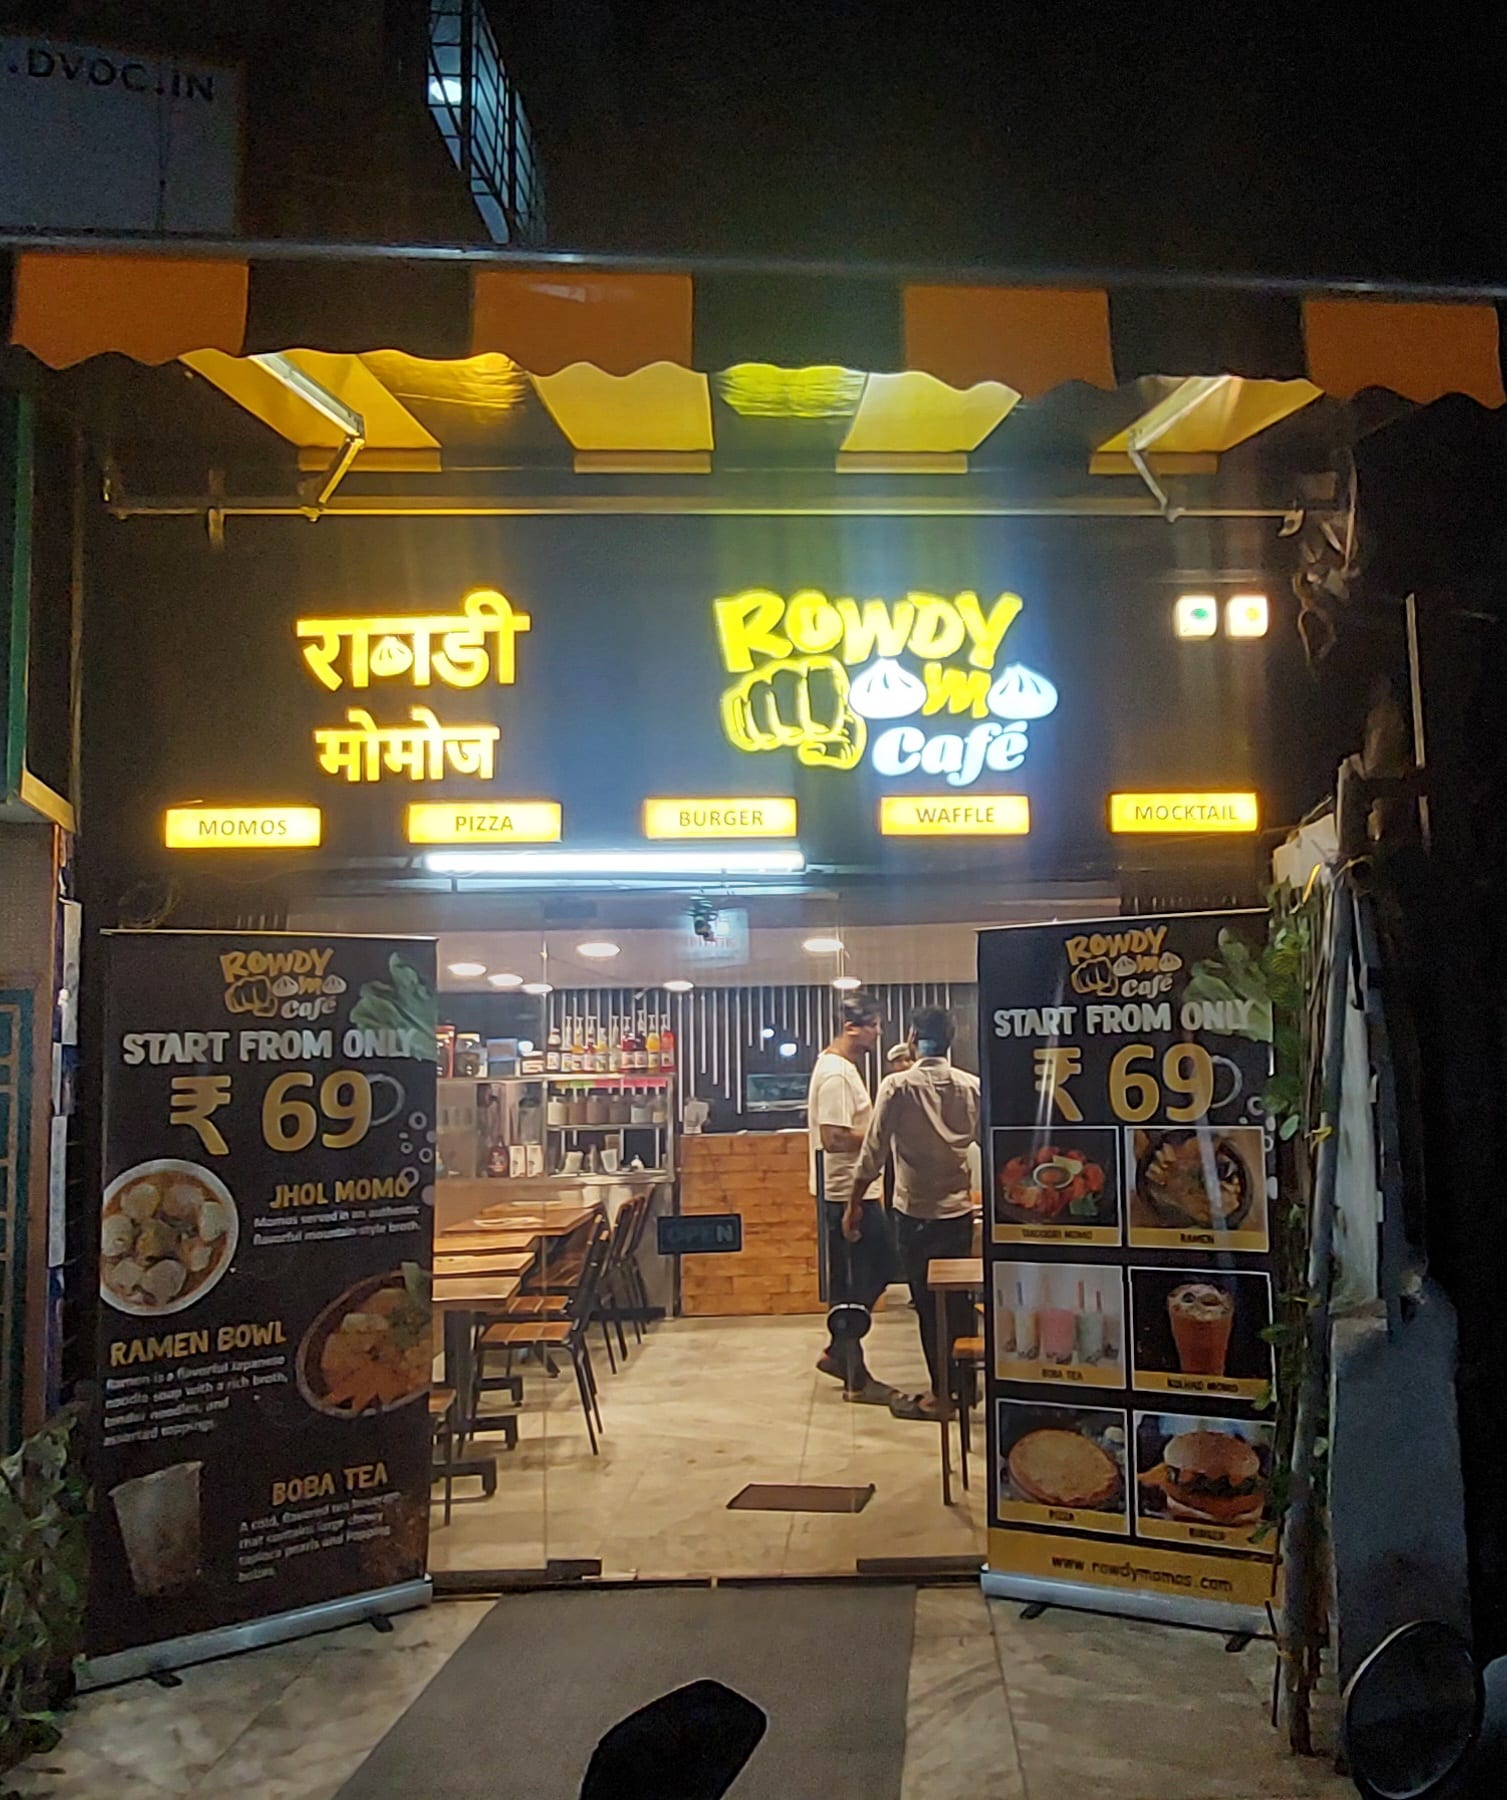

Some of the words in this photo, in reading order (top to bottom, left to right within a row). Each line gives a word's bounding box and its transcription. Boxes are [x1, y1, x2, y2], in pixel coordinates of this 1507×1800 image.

[713, 588, 1023, 672] ROWDY
[314, 706, 500, 783] मोमोज
[872, 721, 1028, 786] Café
[198, 819, 289, 837] MOMOS
[454, 815, 514, 833] PIZZA
[678, 808, 764, 827] BURGER
[915, 806, 996, 824] WAFFLE
[1134, 803, 1239, 822] MOCKTAIL
[1065, 925, 1167, 963] ROWDY
[219, 947, 335, 984] ROWDY
[994, 1005, 1076, 1038] START
[1086, 1002, 1171, 1035] FROM
[1181, 999, 1253, 1033] ONLY
[122, 1031, 230, 1066] START
[239, 1028, 332, 1062] FROM
[343, 1028, 415, 1060] ONLY
[1033, 1047, 1084, 1123] ₹
[1109, 1042, 1215, 1123] 69
[170, 1074, 232, 1156] ₹
[261, 1069, 373, 1153] 69
[268, 1182, 327, 1209] JHOL
[334, 1176, 411, 1203] MOMO
[110, 1329, 209, 1367] RAMEN
[217, 1320, 287, 1353] BOWL
[272, 1471, 336, 1507] BOBA
[343, 1461, 388, 1491] TEA
